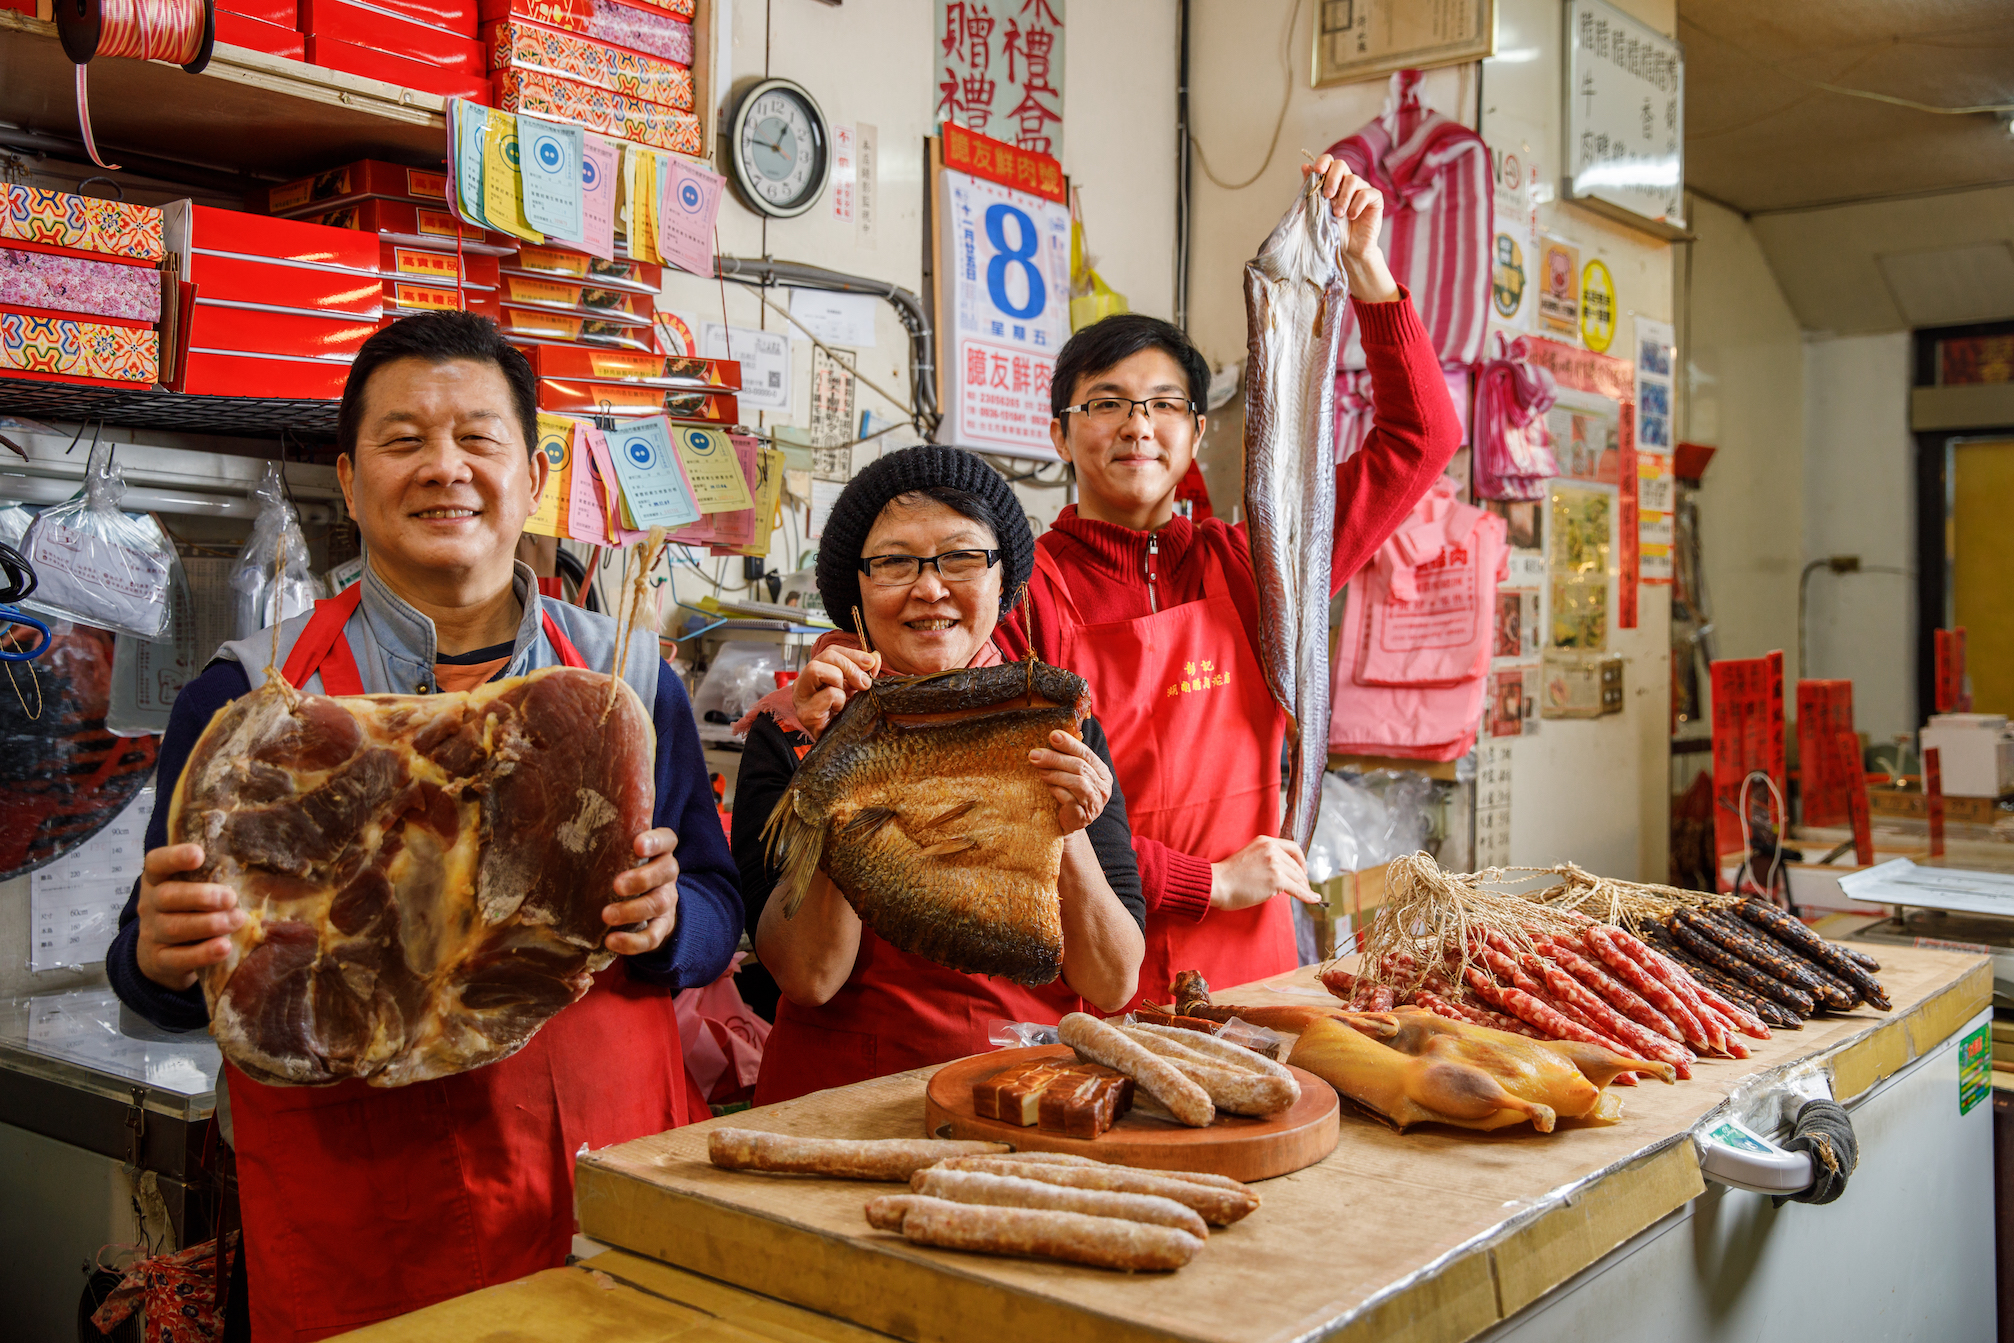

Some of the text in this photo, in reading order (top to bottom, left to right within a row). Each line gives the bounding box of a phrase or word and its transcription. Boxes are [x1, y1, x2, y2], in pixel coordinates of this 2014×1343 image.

[757, 102, 767, 116] 11
[771, 100, 785, 114] 12
[799, 151, 809, 164] 3
[754, 175, 763, 187] 7
[767, 185, 777, 199] 6
[782, 182, 792, 197] 5
[985, 203, 1047, 321] 8
[991, 320, 1046, 346] 星期五
[111, 828, 130, 836] 90cm
[111, 847, 123, 855] 140
[70, 908, 89, 917] 60cm
